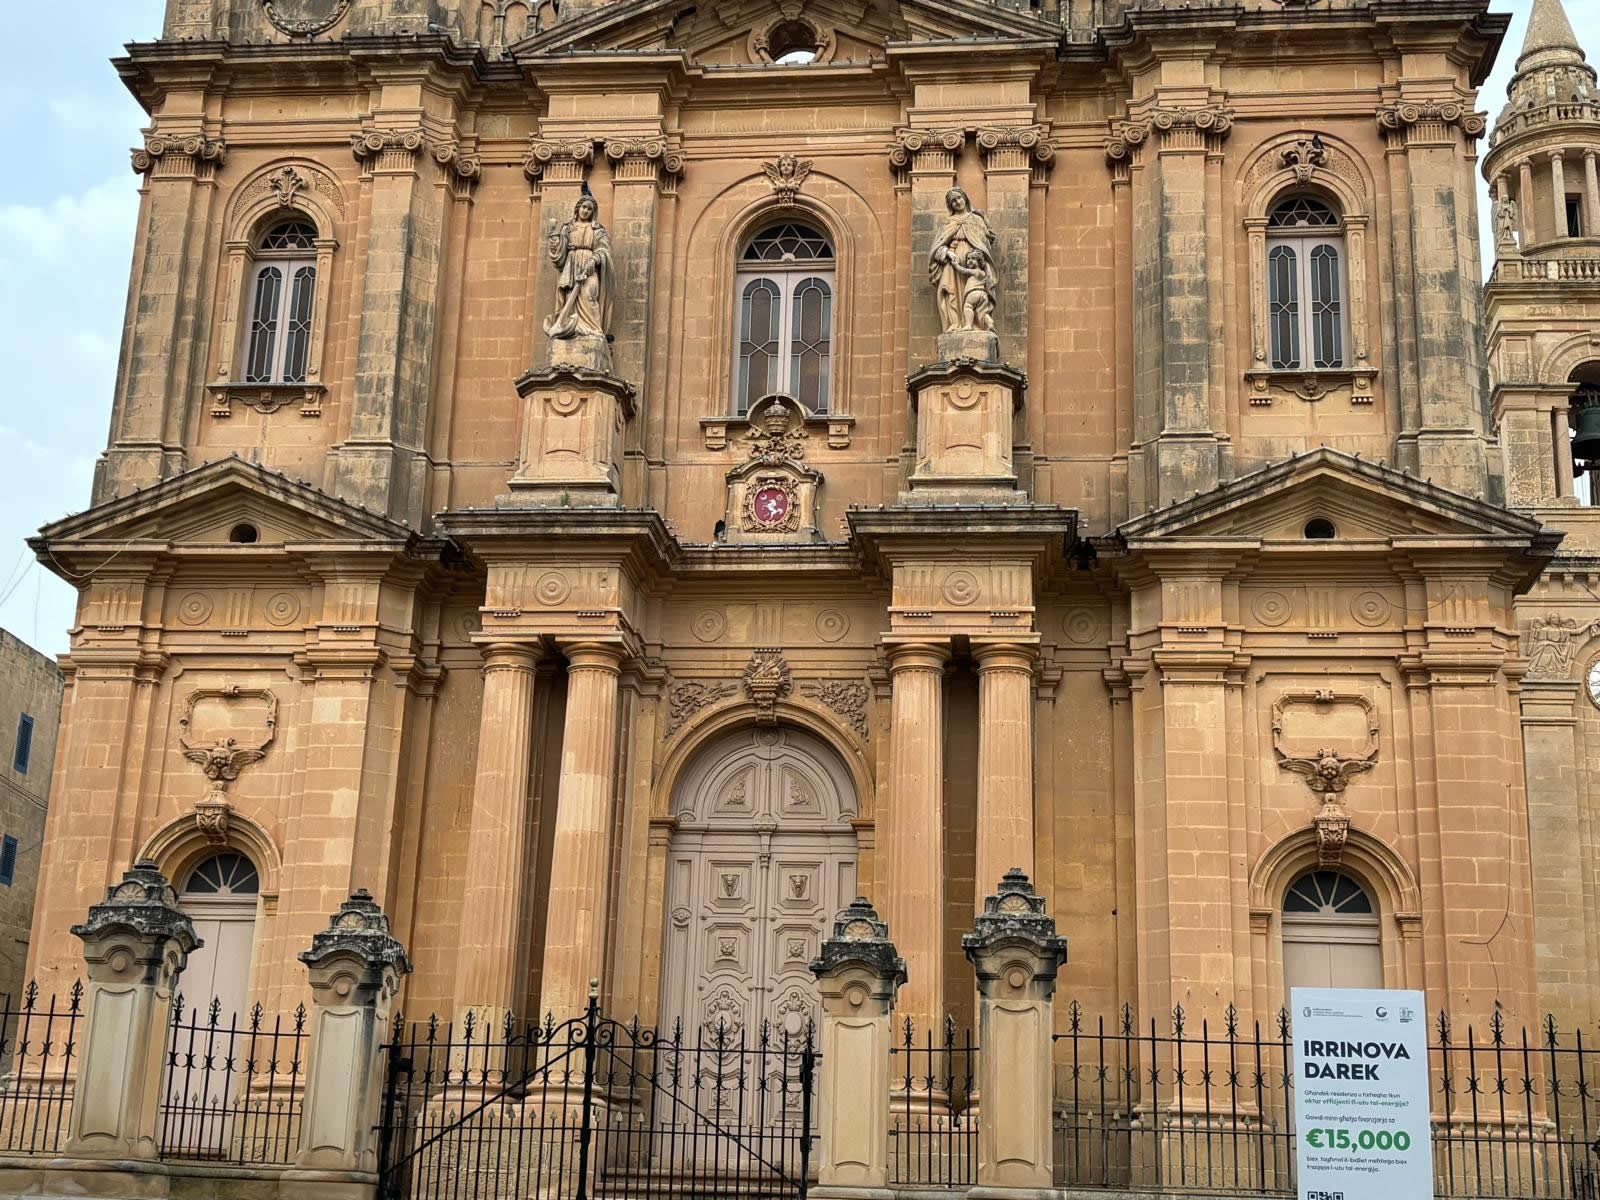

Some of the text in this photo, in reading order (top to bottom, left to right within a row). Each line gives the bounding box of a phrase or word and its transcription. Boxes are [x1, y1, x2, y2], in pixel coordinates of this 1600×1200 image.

[1304, 1040, 1410, 1059] IRRINOVA
[1304, 1062, 1379, 1080] DAREK
[1305, 1128, 1411, 1153] €15,000
